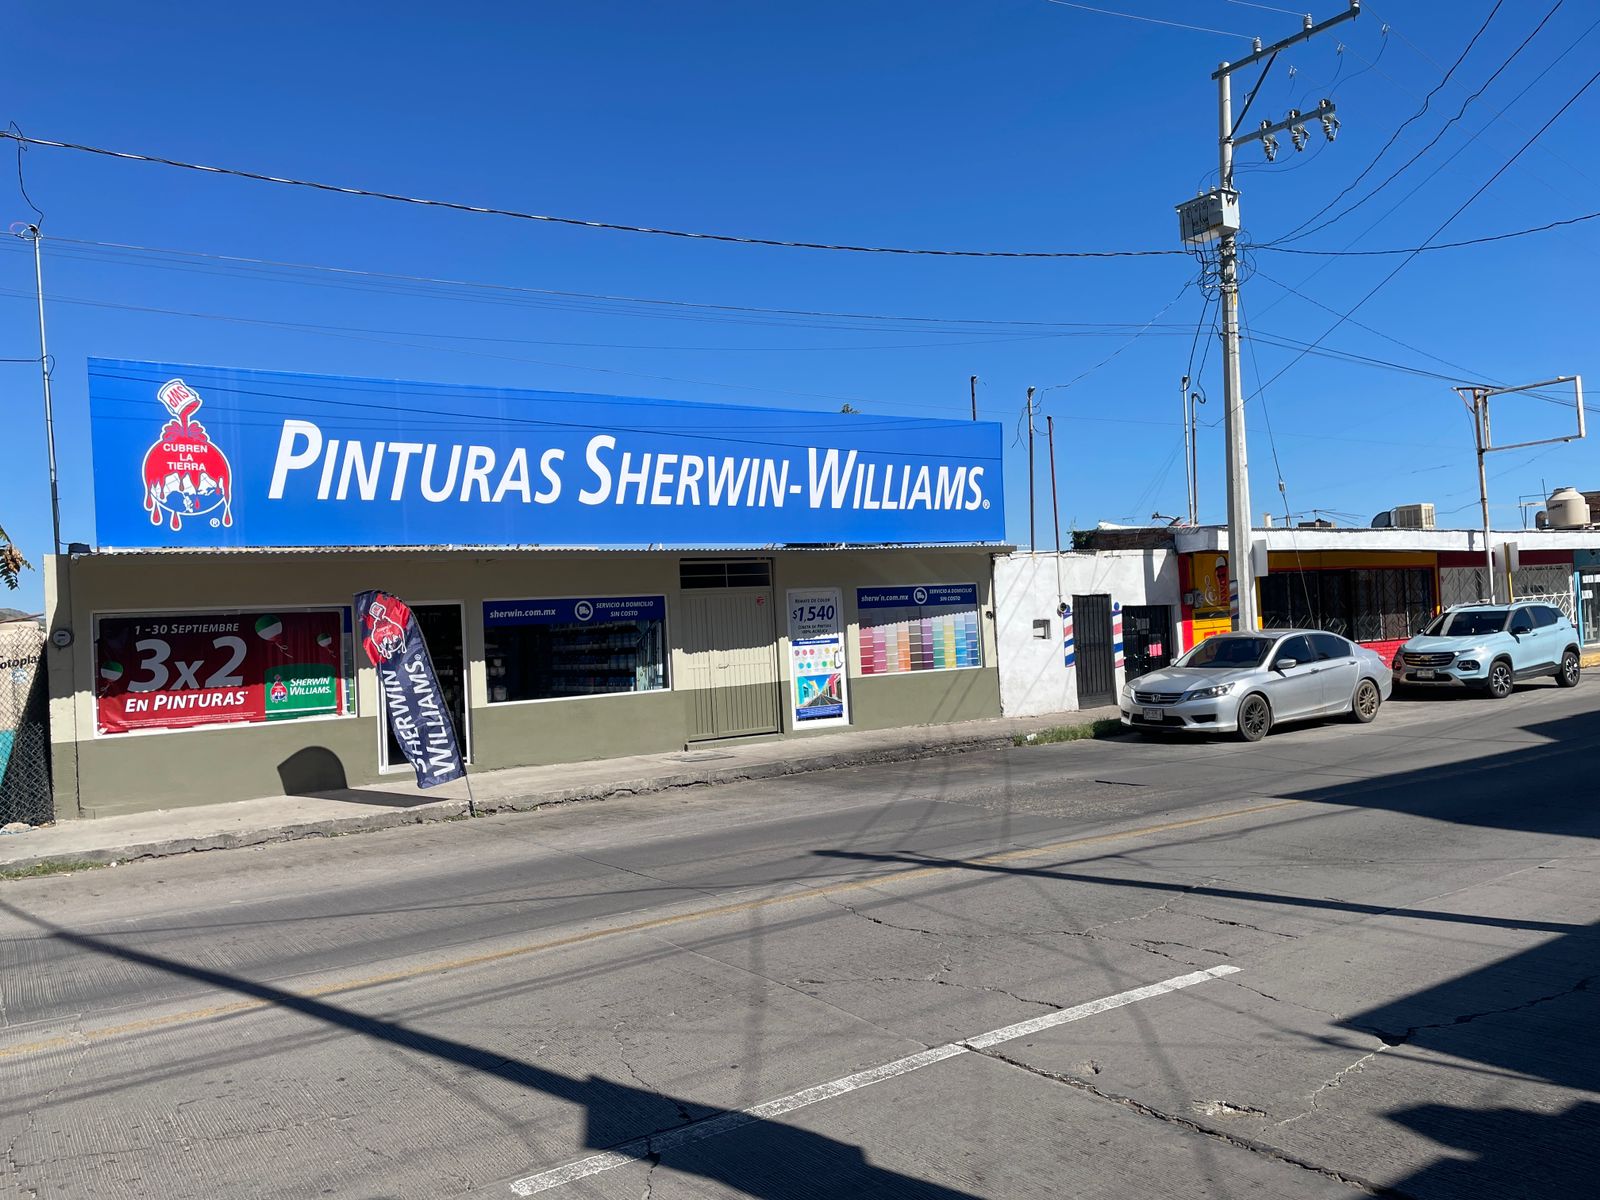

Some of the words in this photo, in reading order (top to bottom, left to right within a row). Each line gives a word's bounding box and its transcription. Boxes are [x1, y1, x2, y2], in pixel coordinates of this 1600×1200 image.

[163, 443, 208, 453] CUBREN
[180, 453, 194, 462] LA
[268, 419, 566, 505] PINTURAS
[167, 462, 206, 472] TIERRA
[861, 594, 908, 602] sherwin.com.mx
[489, 608, 556, 618] sherwin.com.mx
[792, 605, 834, 622] $1,540
[171, 623, 239, 634] SEPTIEMBRE
[290, 677, 330, 687] SHERWIN
[125, 698, 148, 712] EN
[382, 670, 427, 774] SHERWIN
